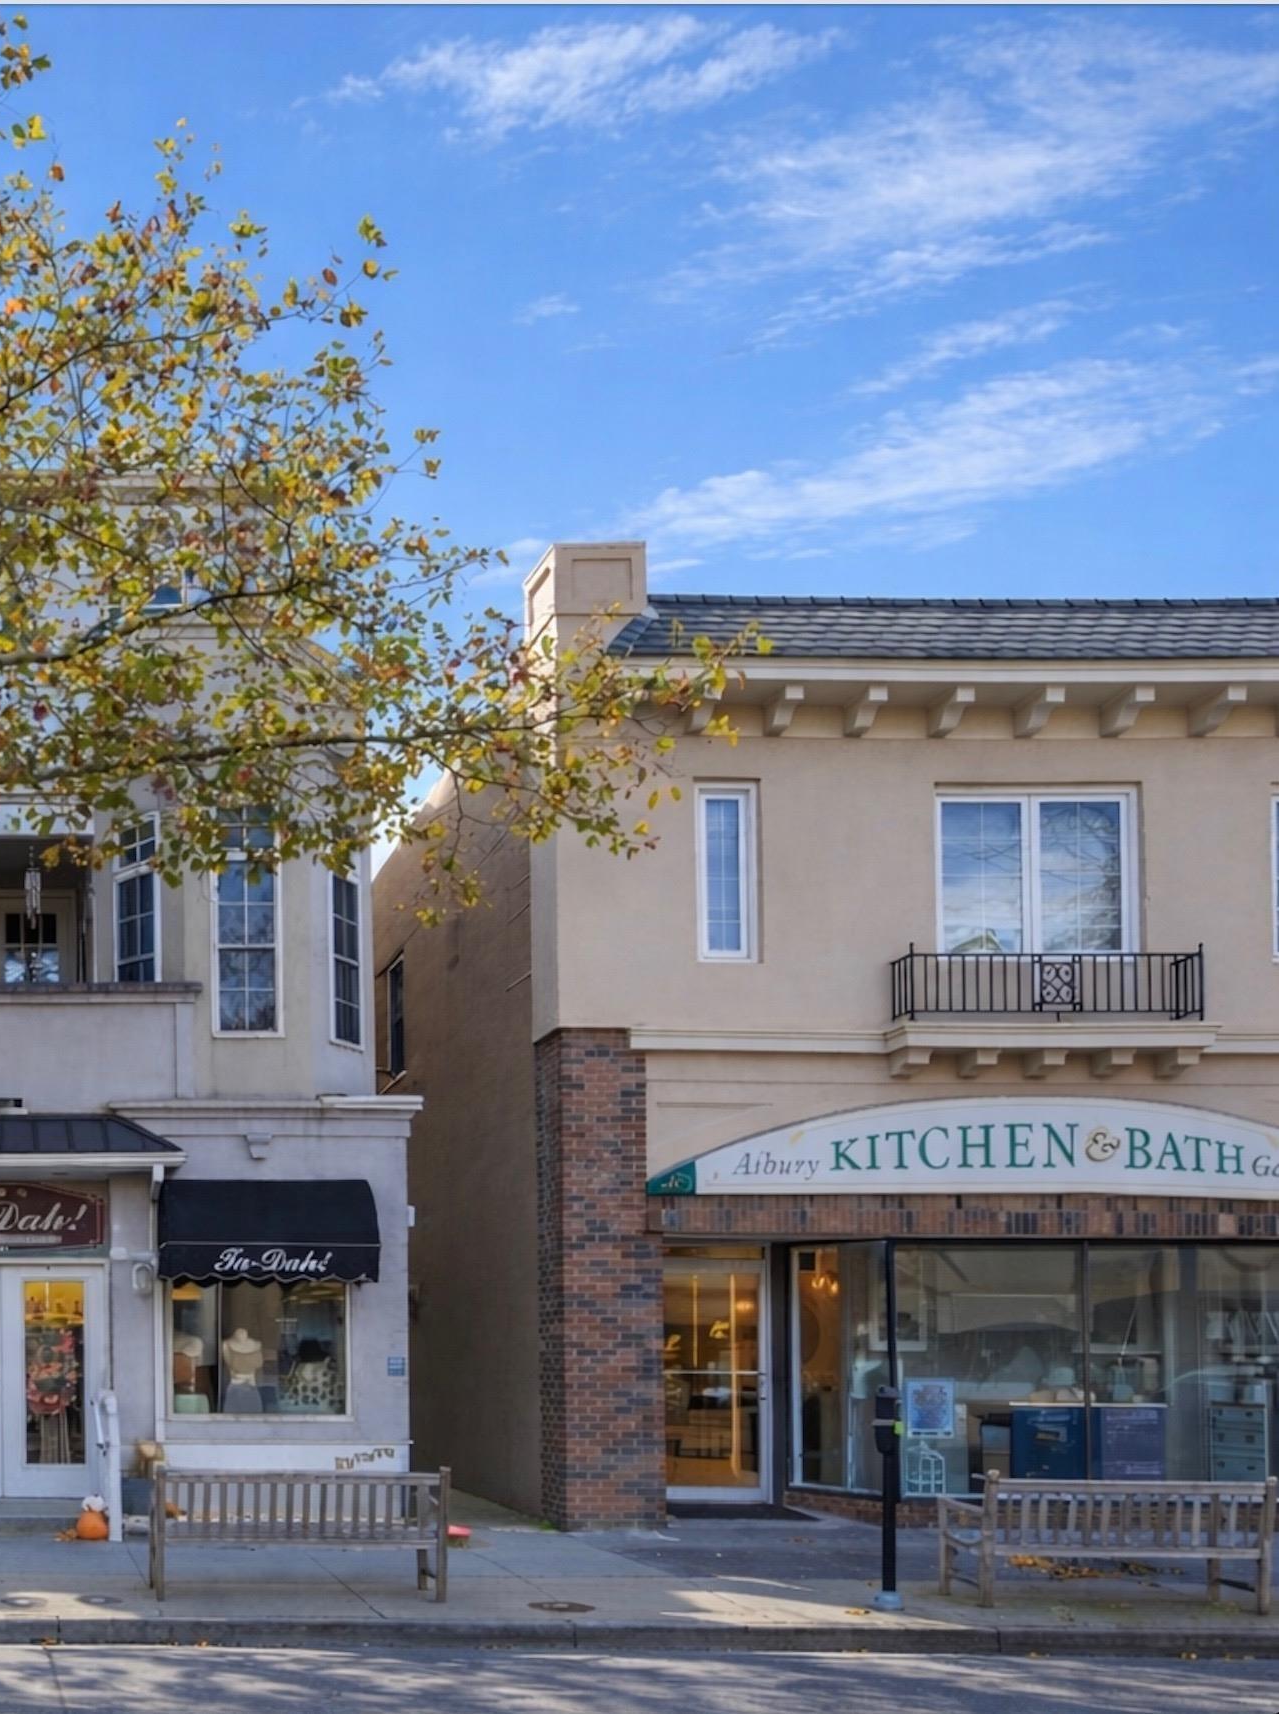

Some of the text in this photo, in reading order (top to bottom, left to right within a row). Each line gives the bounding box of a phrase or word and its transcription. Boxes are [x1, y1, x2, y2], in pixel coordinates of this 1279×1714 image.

[829, 1123, 1079, 1171] KITCHEN
[1085, 1126, 1120, 1162] &
[1124, 1127, 1245, 1175] BATH
